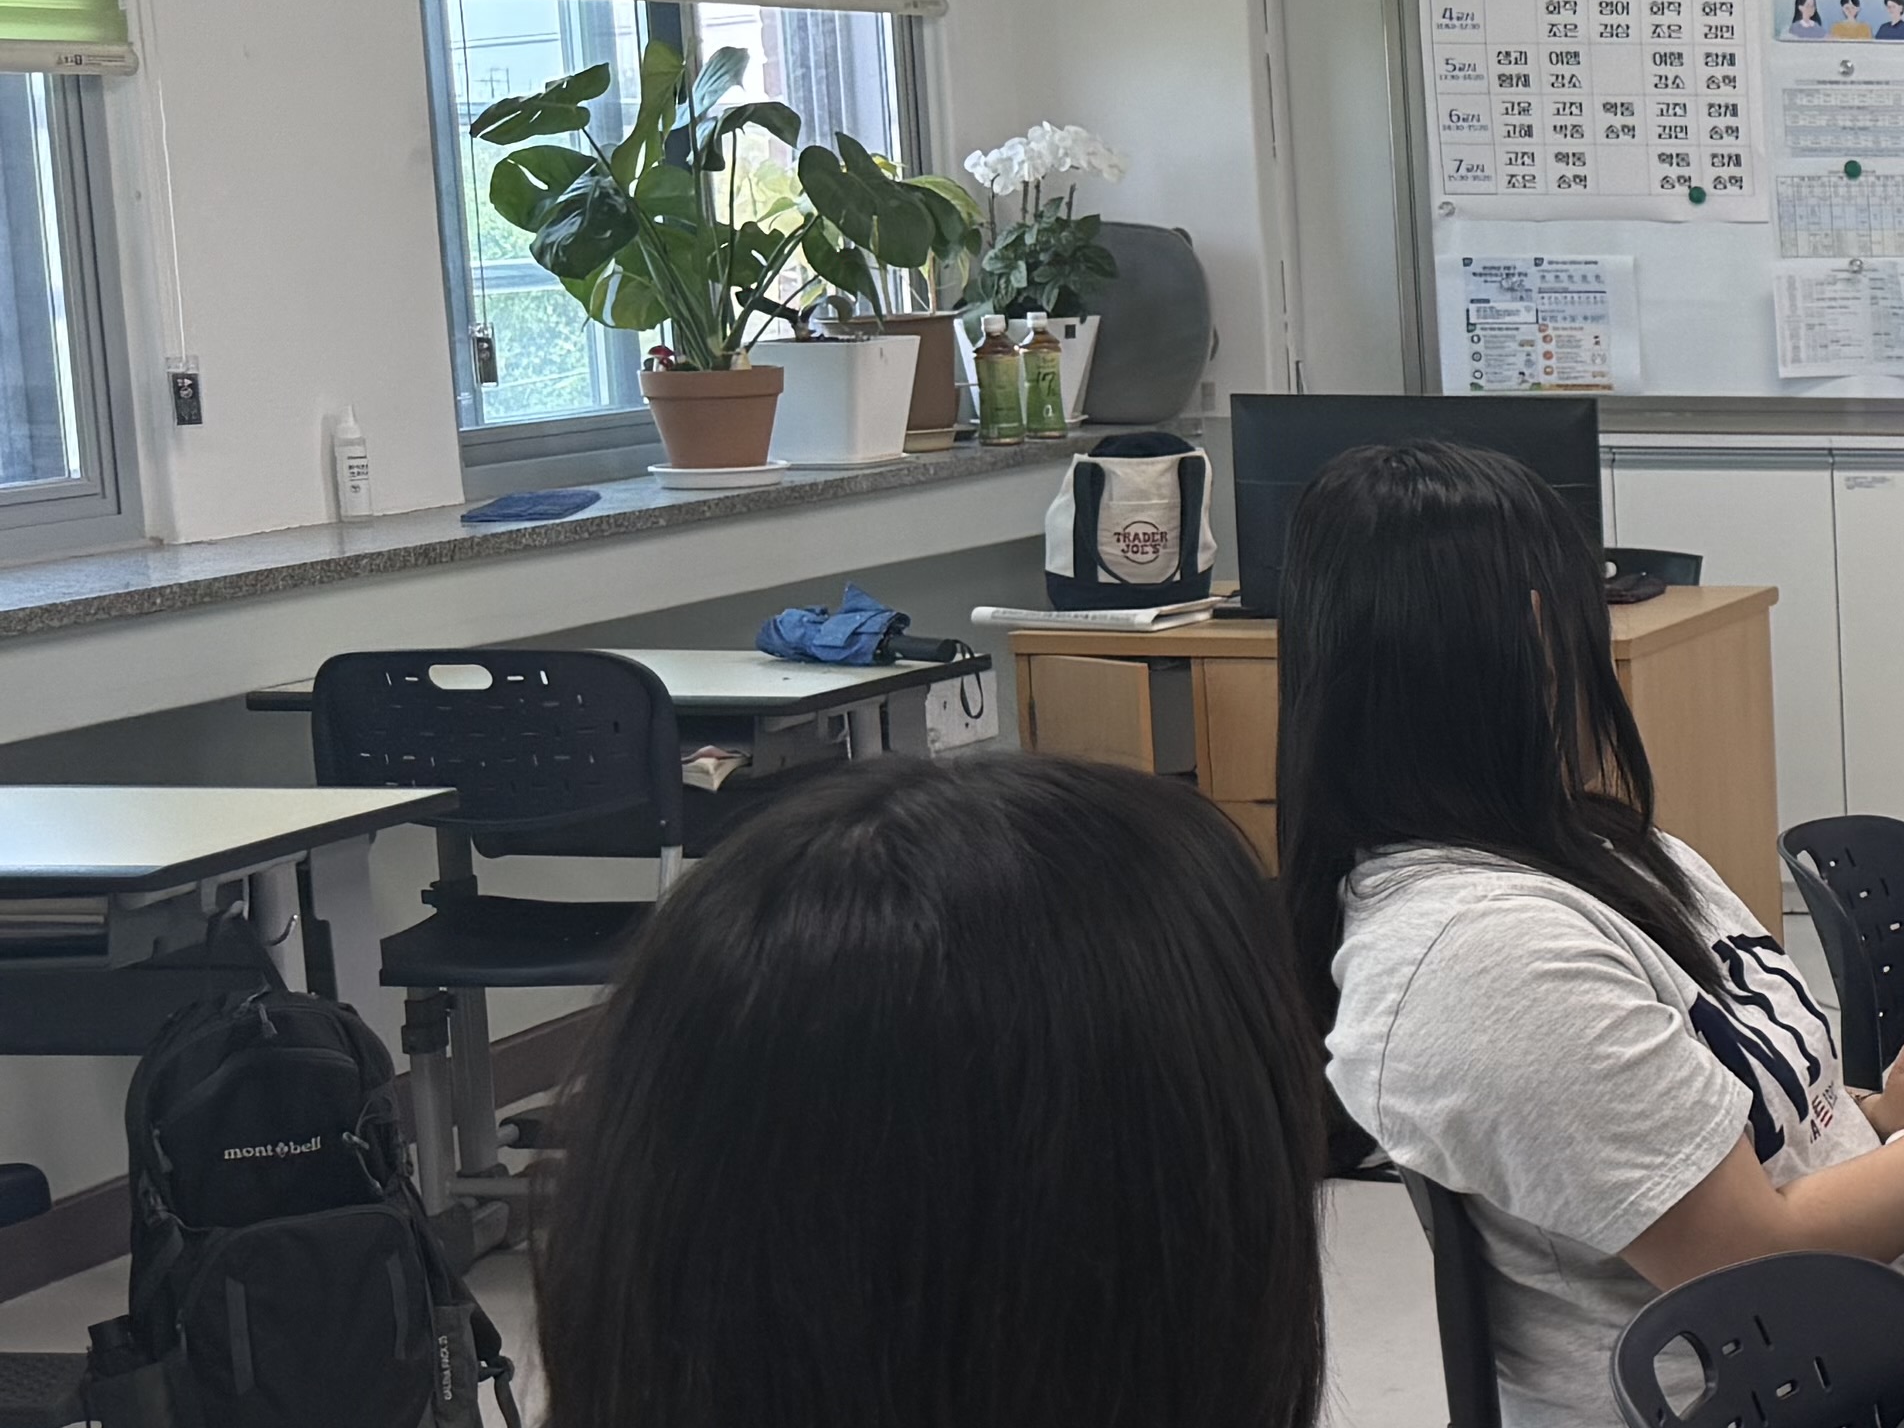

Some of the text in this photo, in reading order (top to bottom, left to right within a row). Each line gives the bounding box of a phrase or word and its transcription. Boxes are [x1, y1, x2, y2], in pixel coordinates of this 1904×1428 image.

[1598, 0, 1630, 16] 영어
[1113, 530, 1168, 543] TRADER
[1121, 542, 1161, 555] JOE'S
